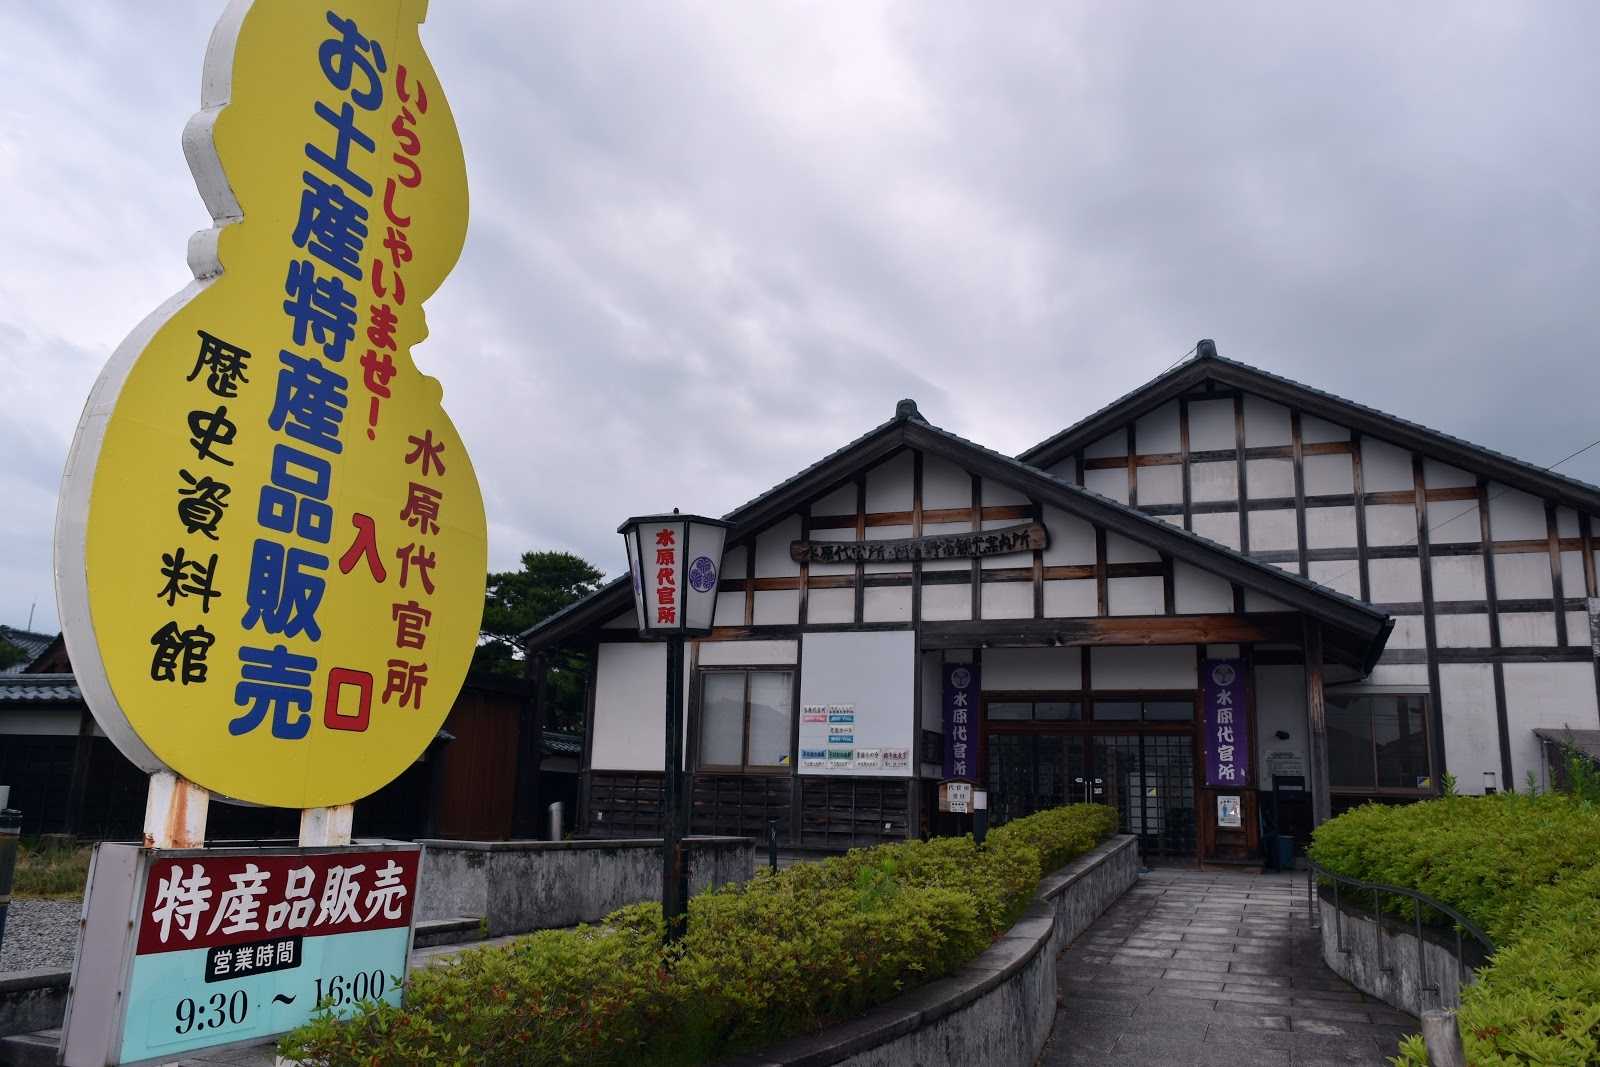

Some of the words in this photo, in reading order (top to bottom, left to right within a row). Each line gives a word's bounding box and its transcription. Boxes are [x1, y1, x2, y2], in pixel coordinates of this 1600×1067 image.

[228, 10, 387, 741] お土産特産品販売
[150, 329, 252, 686] 歴史資料館
[381, 429, 446, 710] 水原代官所
[655, 528, 676, 625] 水原代官所
[323, 512, 387, 732] 入口
[952, 691, 968, 776] 水原代官所
[1216, 689, 1236, 780] 水原代官所
[152, 859, 408, 944] 特産品販売
[175, 989, 249, 1035] 9:30
[313, 969, 386, 1009] 16:00
[213, 940, 295, 976] 営業時間
